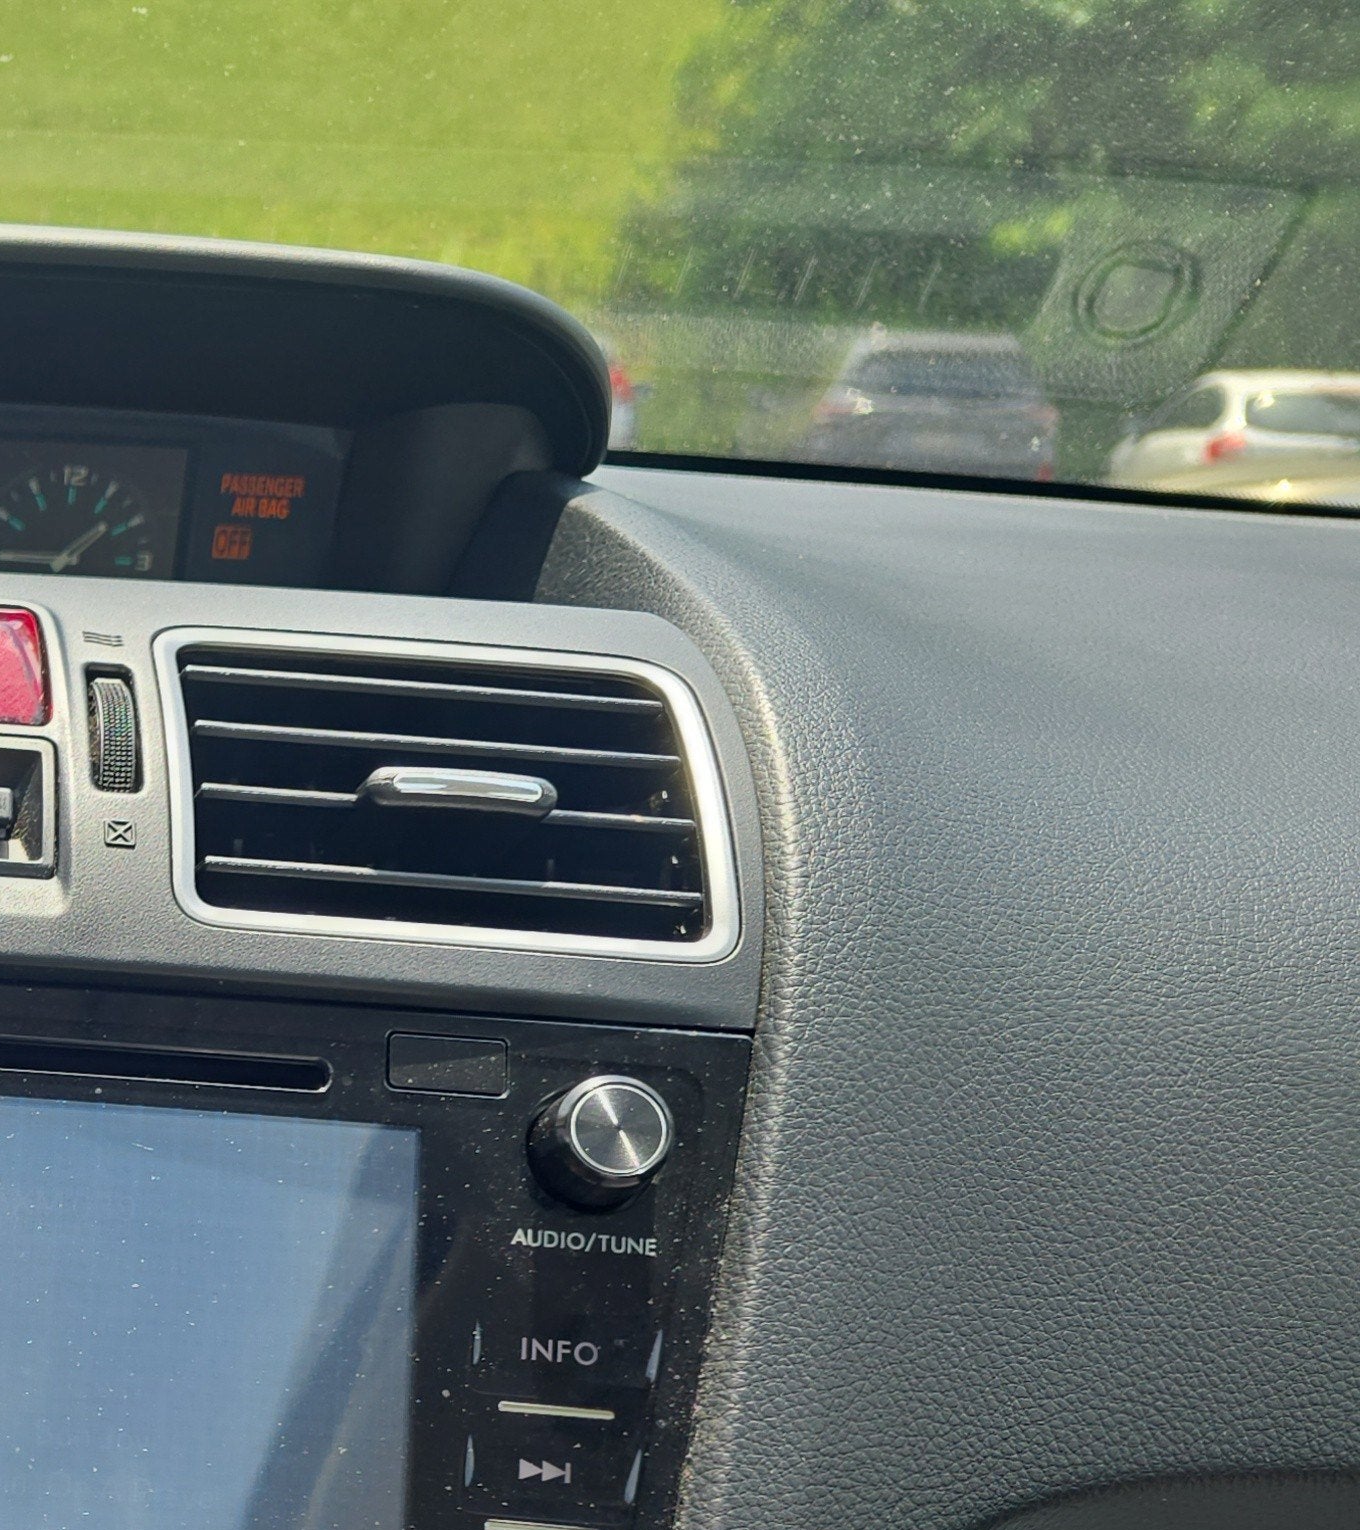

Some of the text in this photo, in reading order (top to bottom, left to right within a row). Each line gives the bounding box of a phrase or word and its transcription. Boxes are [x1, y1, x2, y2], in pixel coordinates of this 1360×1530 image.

[63, 466, 88, 487] 12
[221, 473, 305, 497] PASSENGER
[231, 497, 290, 519] AIR BAG
[214, 527, 251, 558] OFF
[511, 1228, 658, 1257] AUDIO/TUNE
[520, 1336, 599, 1366] INFO
